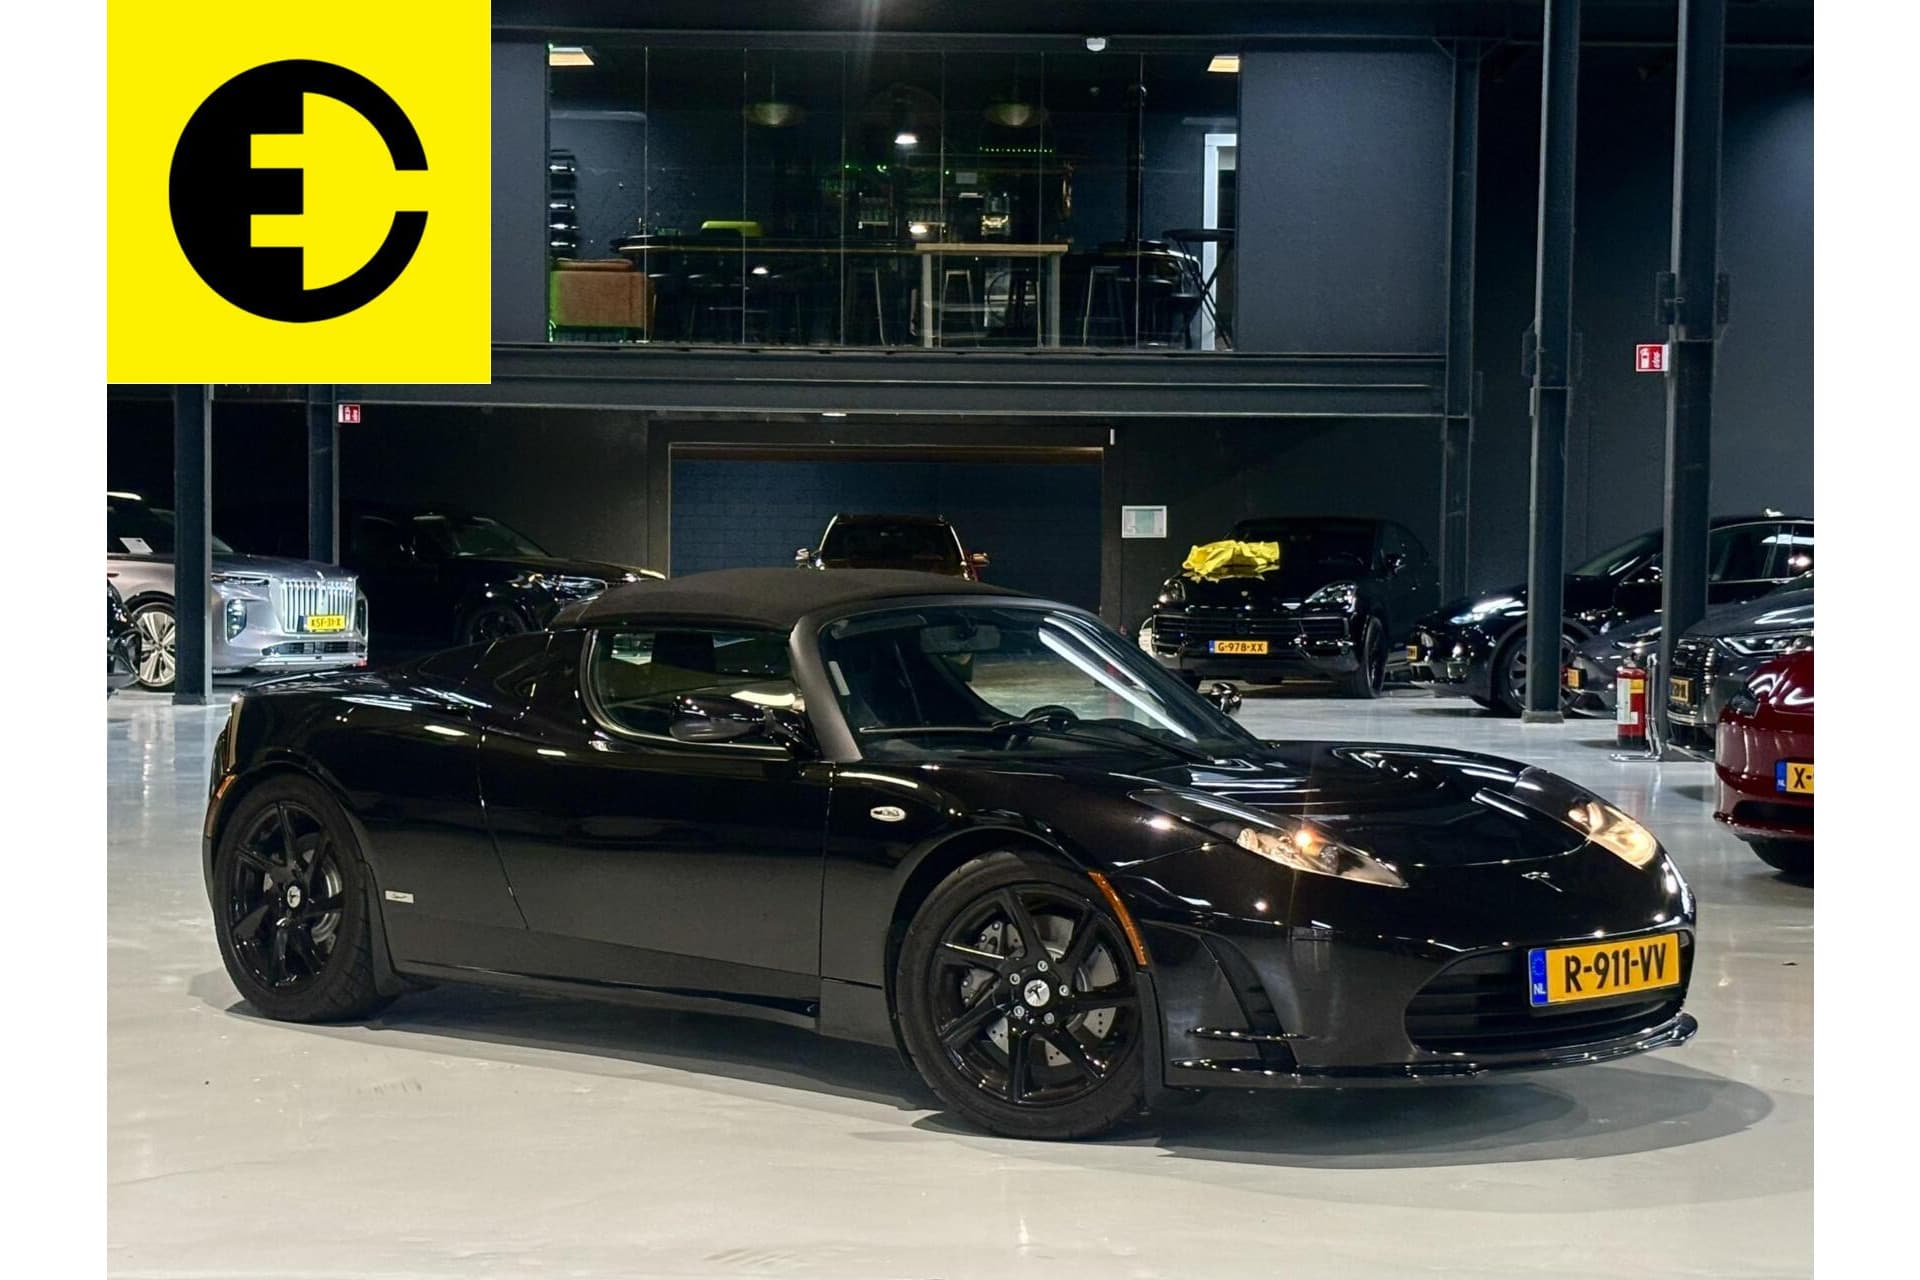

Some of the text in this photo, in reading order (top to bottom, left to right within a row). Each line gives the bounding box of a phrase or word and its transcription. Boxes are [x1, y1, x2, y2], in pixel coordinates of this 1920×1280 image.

[1217, 642, 1265, 653] G-978-XX
[1564, 942, 1667, 994] R-911-VV
[1533, 982, 1547, 996] NL
